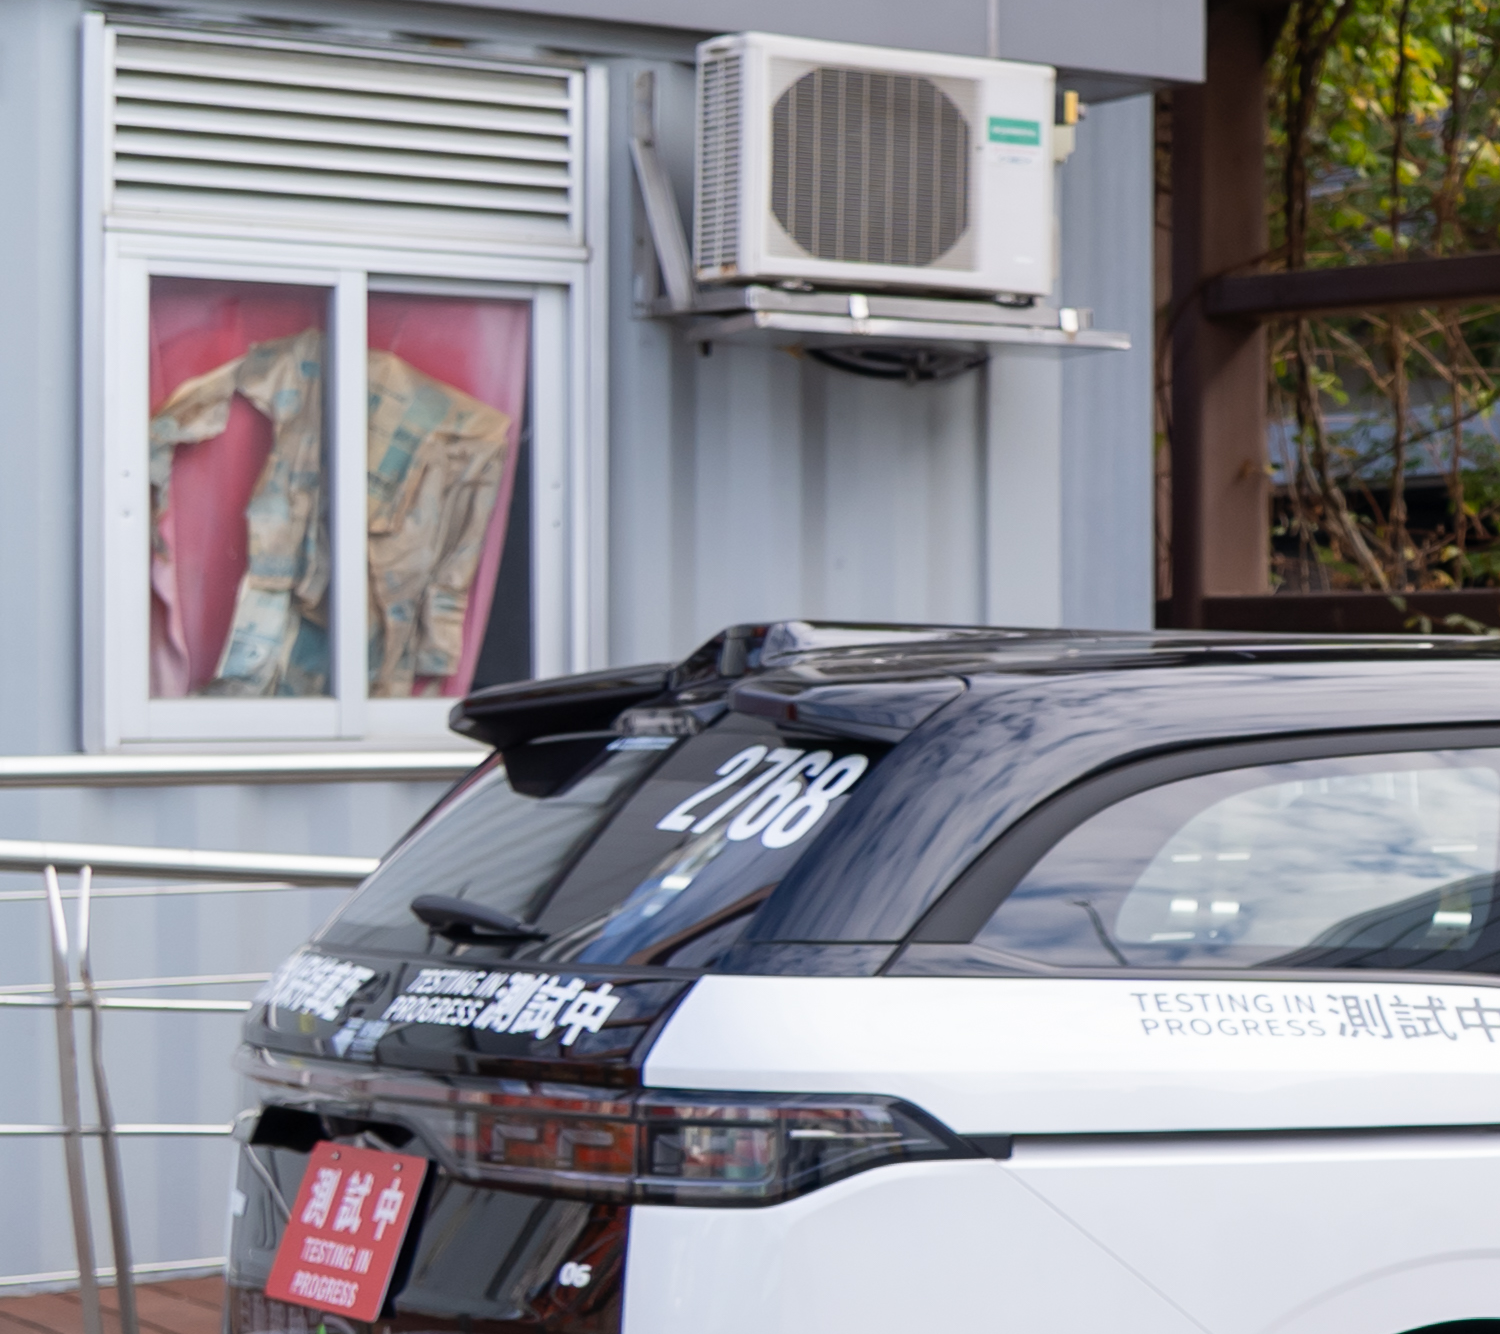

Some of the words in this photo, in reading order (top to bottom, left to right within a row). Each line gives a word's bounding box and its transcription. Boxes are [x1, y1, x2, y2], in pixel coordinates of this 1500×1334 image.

[656, 744, 869, 849] 2768
[406, 968, 486, 995] TESTING
[474, 971, 509, 998] IN
[380, 995, 485, 1027] PROGRESS
[473, 971, 622, 1047] 測試中
[1130, 992, 1274, 1014] TESTING
[1284, 994, 1317, 1015] IN
[1140, 1017, 1326, 1038] PROGRESS
[300, 1167, 405, 1242] 測試中
[301, 1236, 355, 1273] TESTING
[352, 1248, 374, 1275] IN
[289, 1269, 360, 1309] PROGRESS
